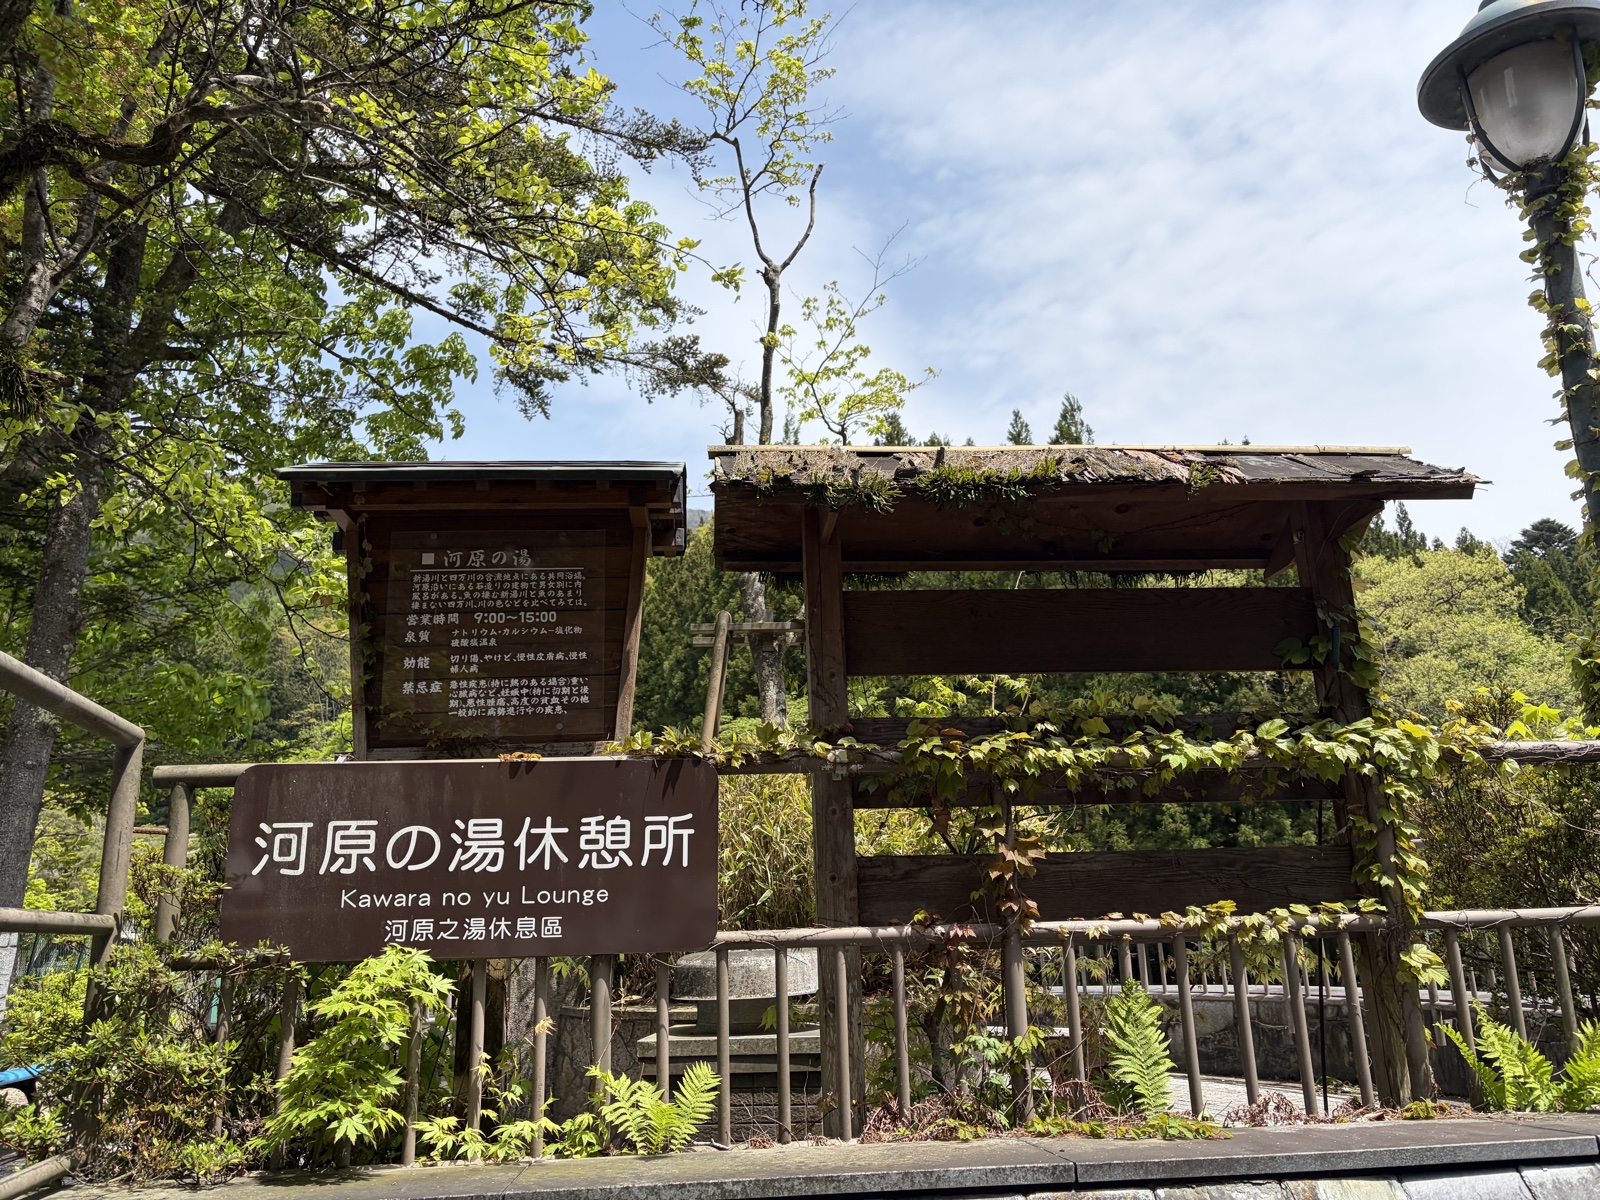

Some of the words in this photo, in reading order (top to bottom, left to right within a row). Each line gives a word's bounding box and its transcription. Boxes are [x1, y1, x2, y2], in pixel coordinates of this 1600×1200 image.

[443, 549, 532, 568] 河原の湯
[405, 613, 459, 626] 営業時間
[404, 630, 431, 643] 泉質
[450, 637, 498, 647] 硫酸塩温泉
[403, 656, 430, 670] 効能
[449, 664, 479, 674] 婦人病
[402, 680, 443, 695] 禁忌症
[251, 813, 695, 876] 河原の湯休憩所
[340, 888, 431, 909] Kawara
[442, 890, 471, 906] no
[482, 889, 510, 909] yu
[521, 884, 610, 907] Lounge
[384, 916, 563, 943] 河原之湯休息區
